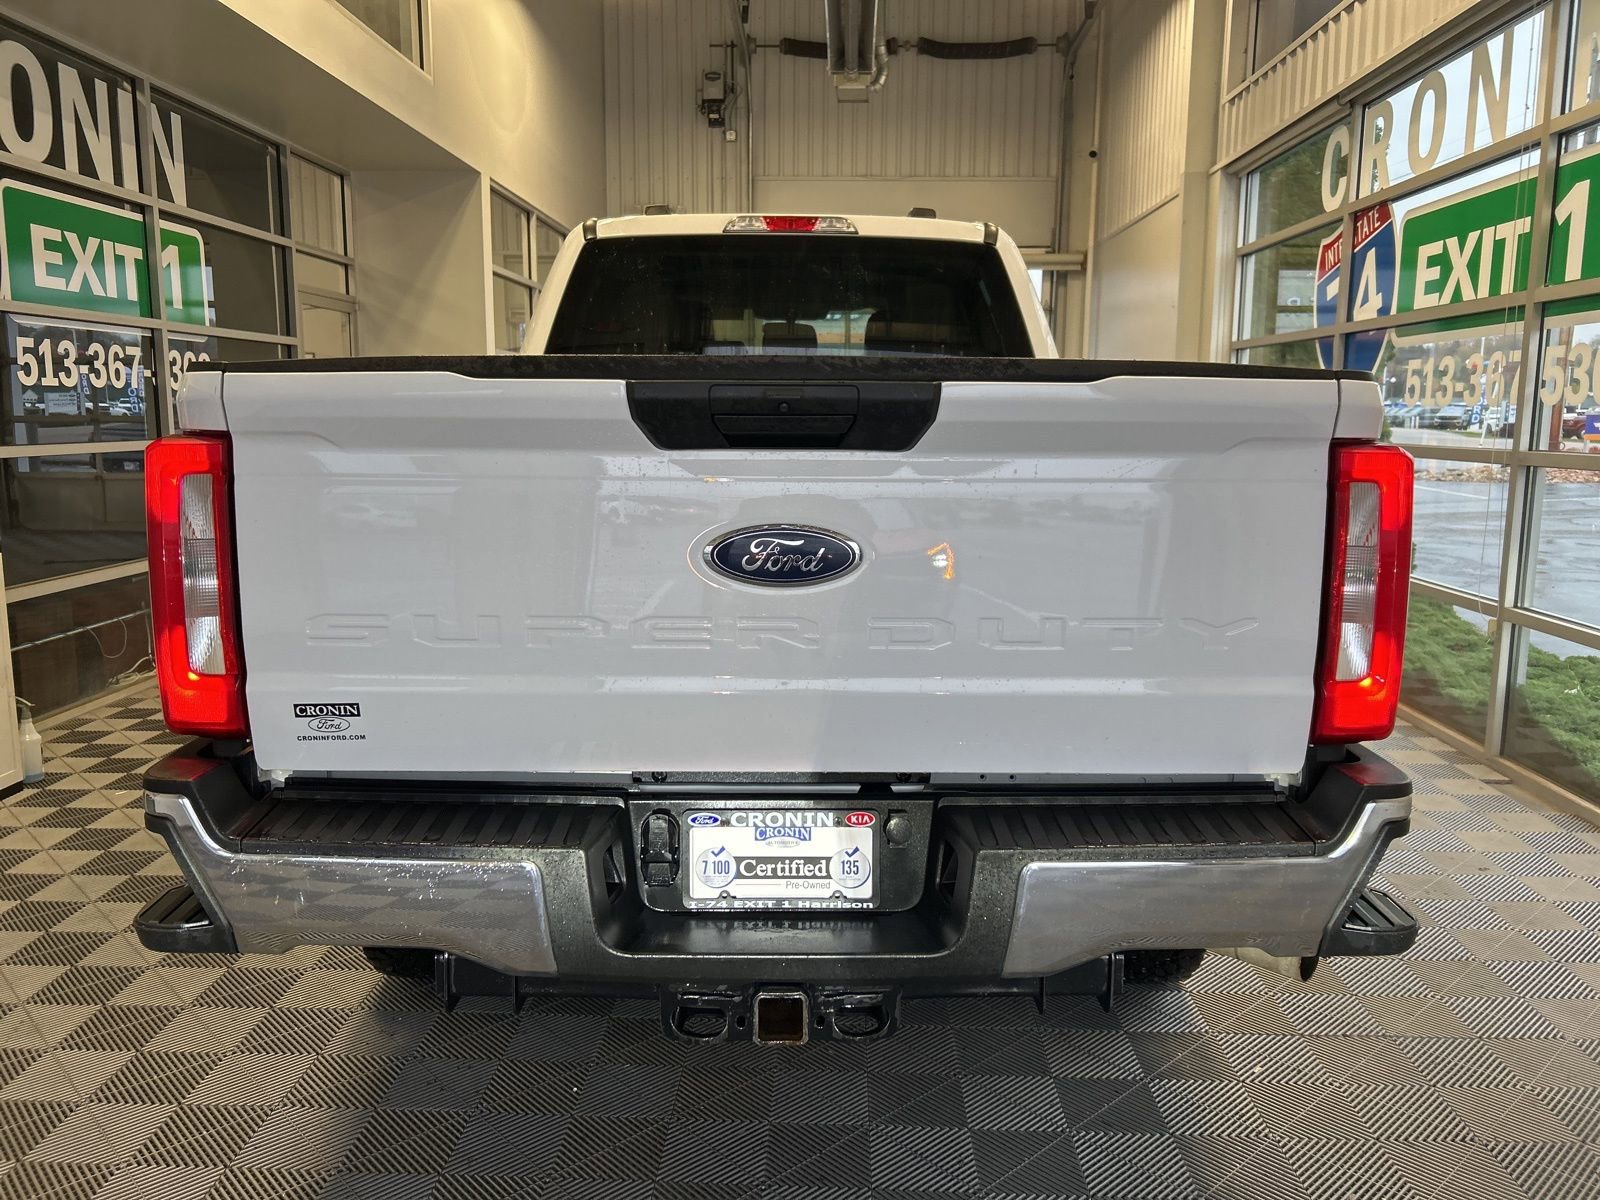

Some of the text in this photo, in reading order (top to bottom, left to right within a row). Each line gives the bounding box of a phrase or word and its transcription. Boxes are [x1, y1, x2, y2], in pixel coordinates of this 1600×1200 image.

[1413, 179, 1590, 311] EXIT 1
[29, 223, 184, 310] EXIT 1
[741, 537, 826, 572] Ford
[305, 612, 1260, 650] SUPER DUTY
[295, 705, 359, 716] CRONIN
[316, 718, 343, 730] Ford
[297, 734, 367, 742] CRONINFORD.COM
[730, 812, 834, 828] CRONIN
[850, 815, 871, 824] KIA
[756, 826, 811, 841] CRONIN
[702, 860, 730, 875] 7 100
[739, 859, 828, 877] Certified
[841, 860, 860, 875] 135
[785, 880, 831, 890] Pre-Owned
[733, 900, 776, 908] EXIT
[781, 900, 792, 908] 1
[799, 900, 874, 909] Harrison
